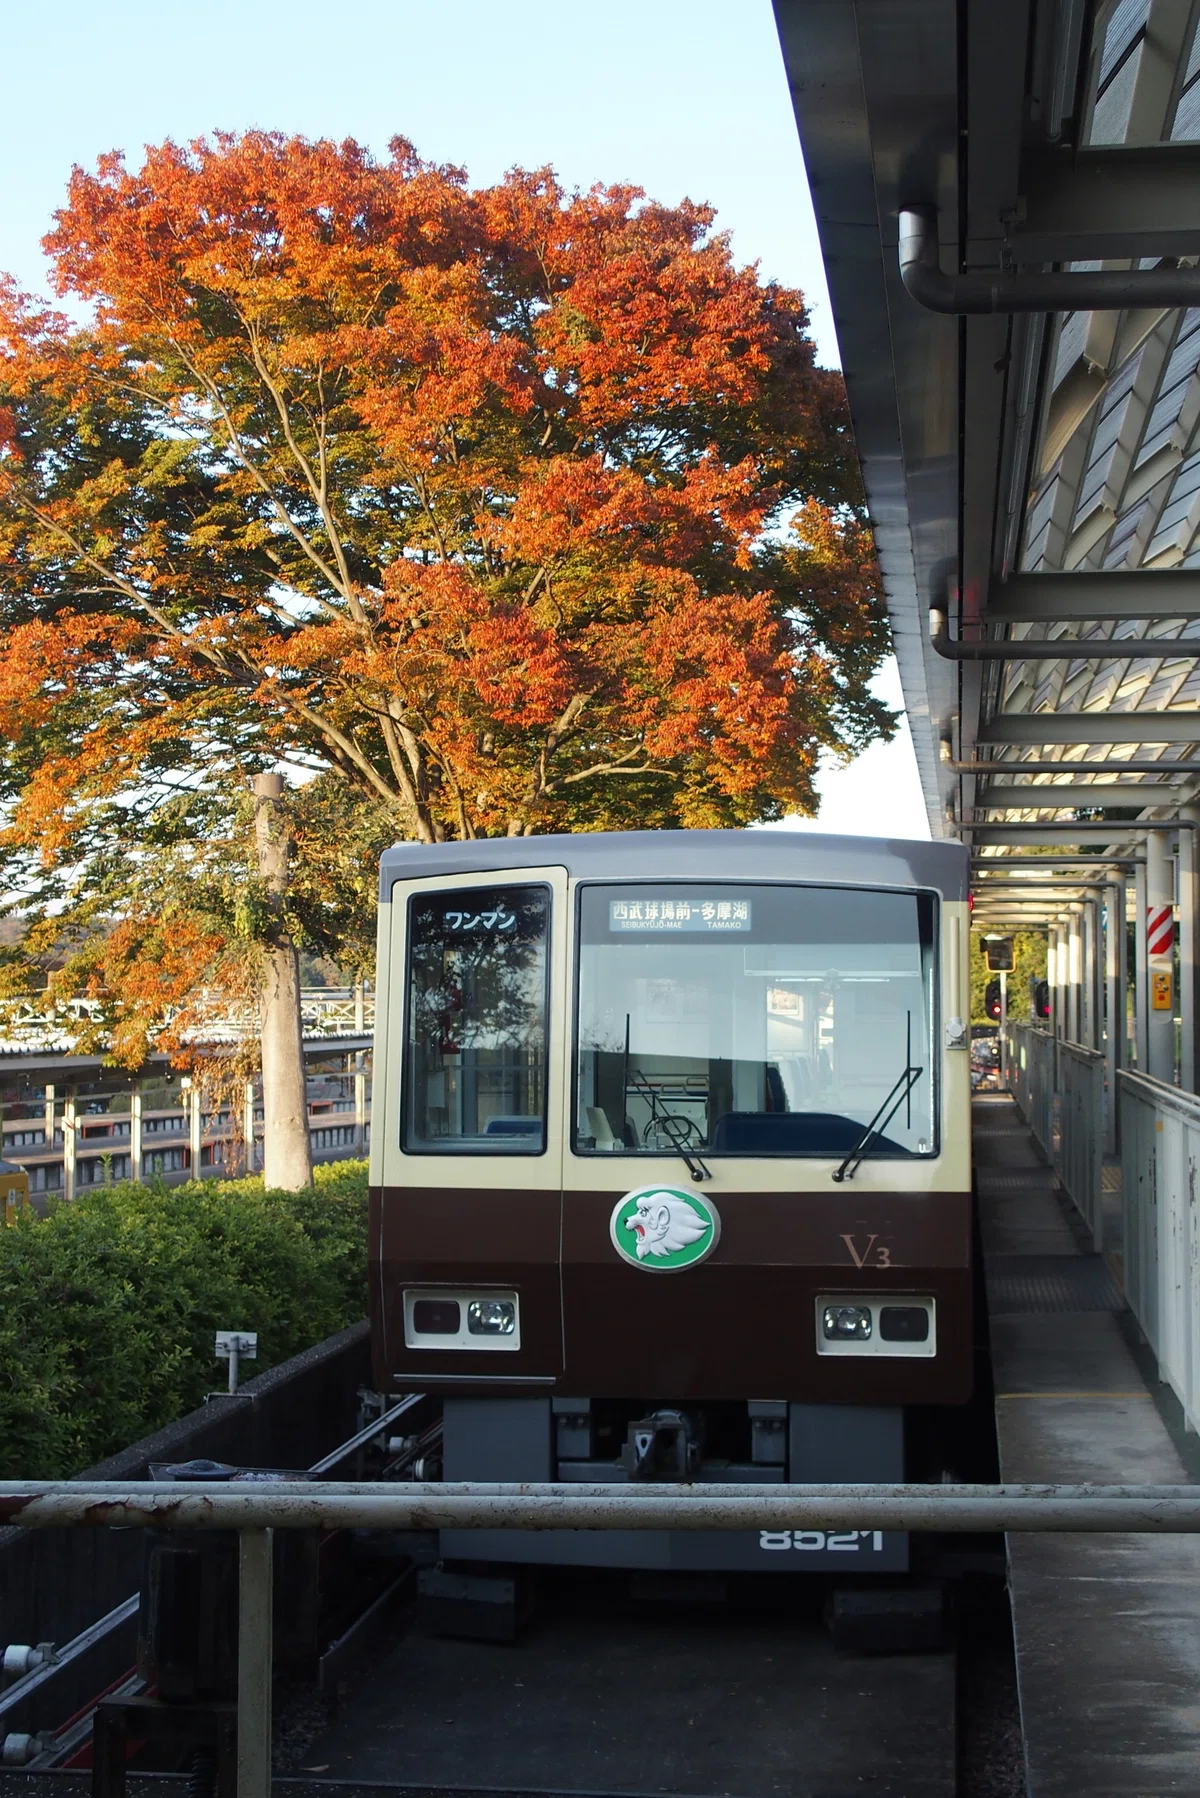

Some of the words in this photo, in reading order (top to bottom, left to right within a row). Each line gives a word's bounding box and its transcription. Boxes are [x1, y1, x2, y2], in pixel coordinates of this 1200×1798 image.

[445, 911, 516, 930] ワンマン
[707, 921, 741, 929] TAMAKO
[839, 1234, 891, 1270] V3
[760, 1530, 882, 1551] 8521
